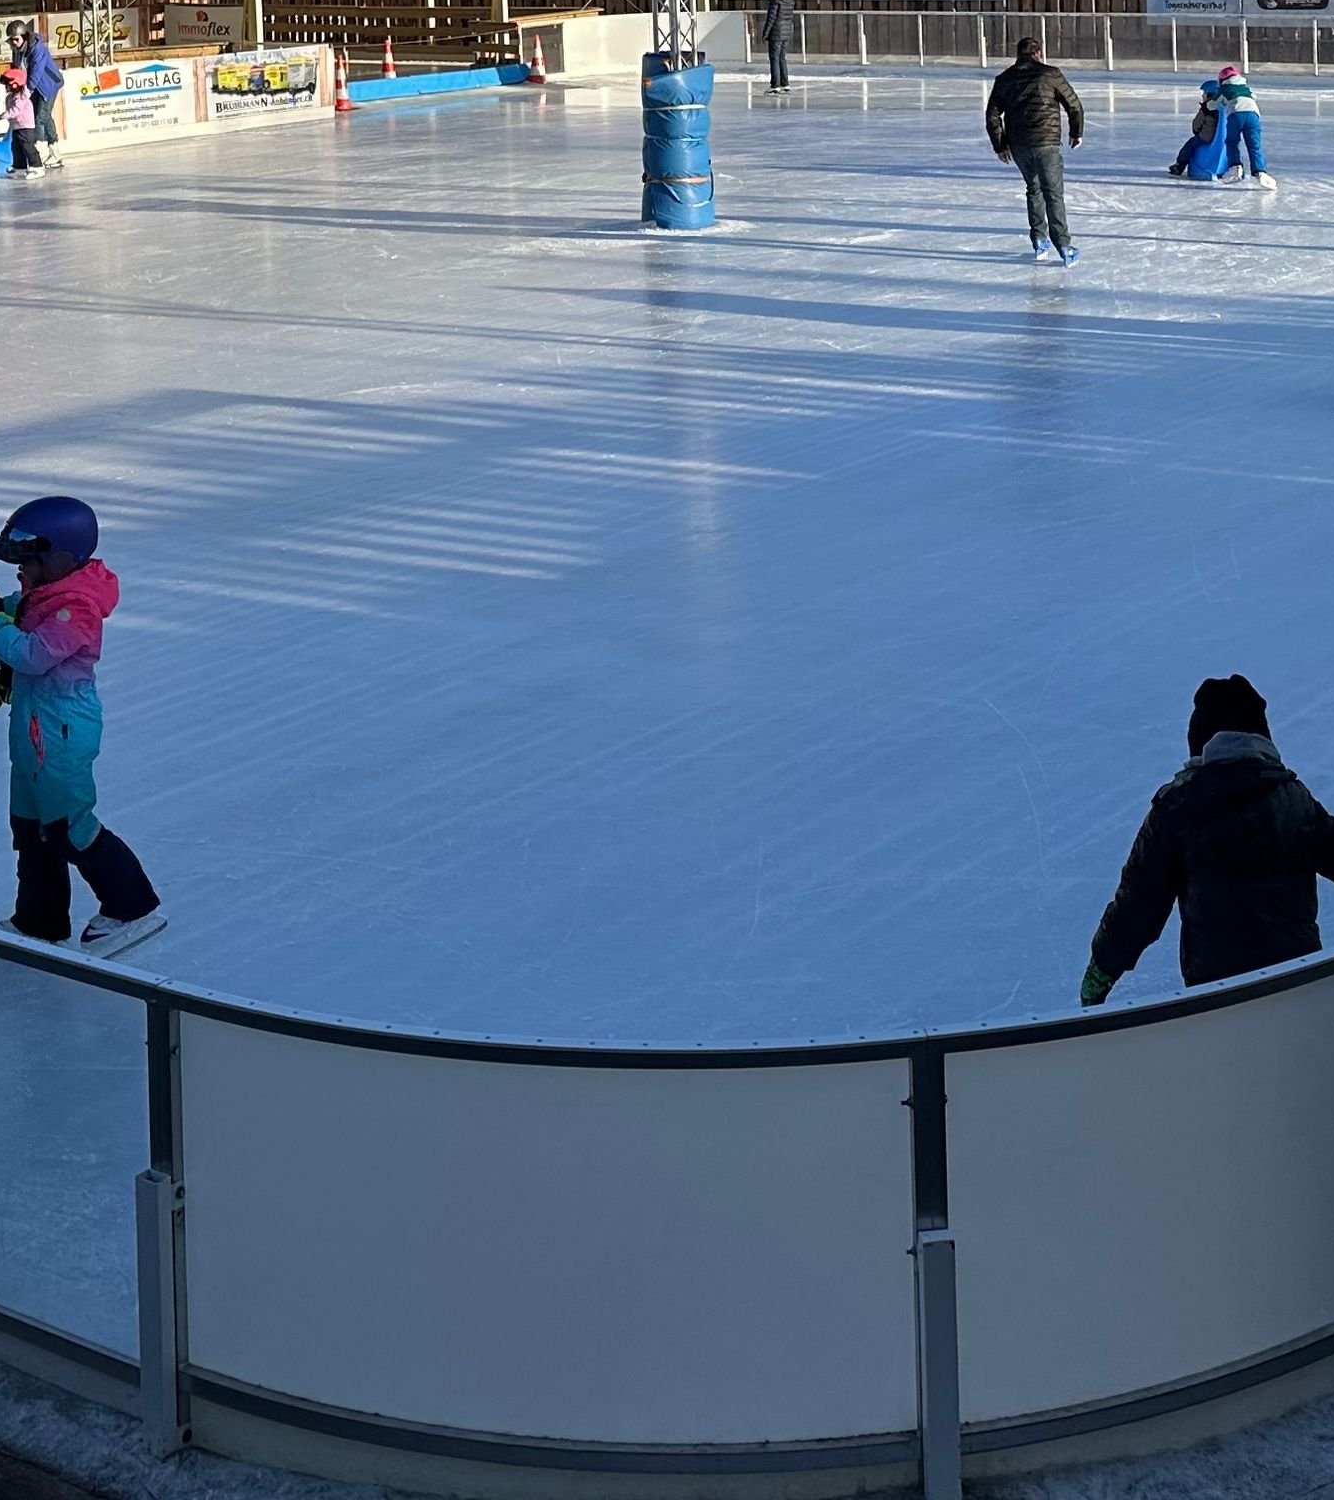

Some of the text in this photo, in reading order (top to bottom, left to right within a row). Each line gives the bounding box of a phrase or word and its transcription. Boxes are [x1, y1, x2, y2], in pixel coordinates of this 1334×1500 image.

[178, 21, 231, 37] immoflex
[125, 71, 181, 90] Dürst AG
